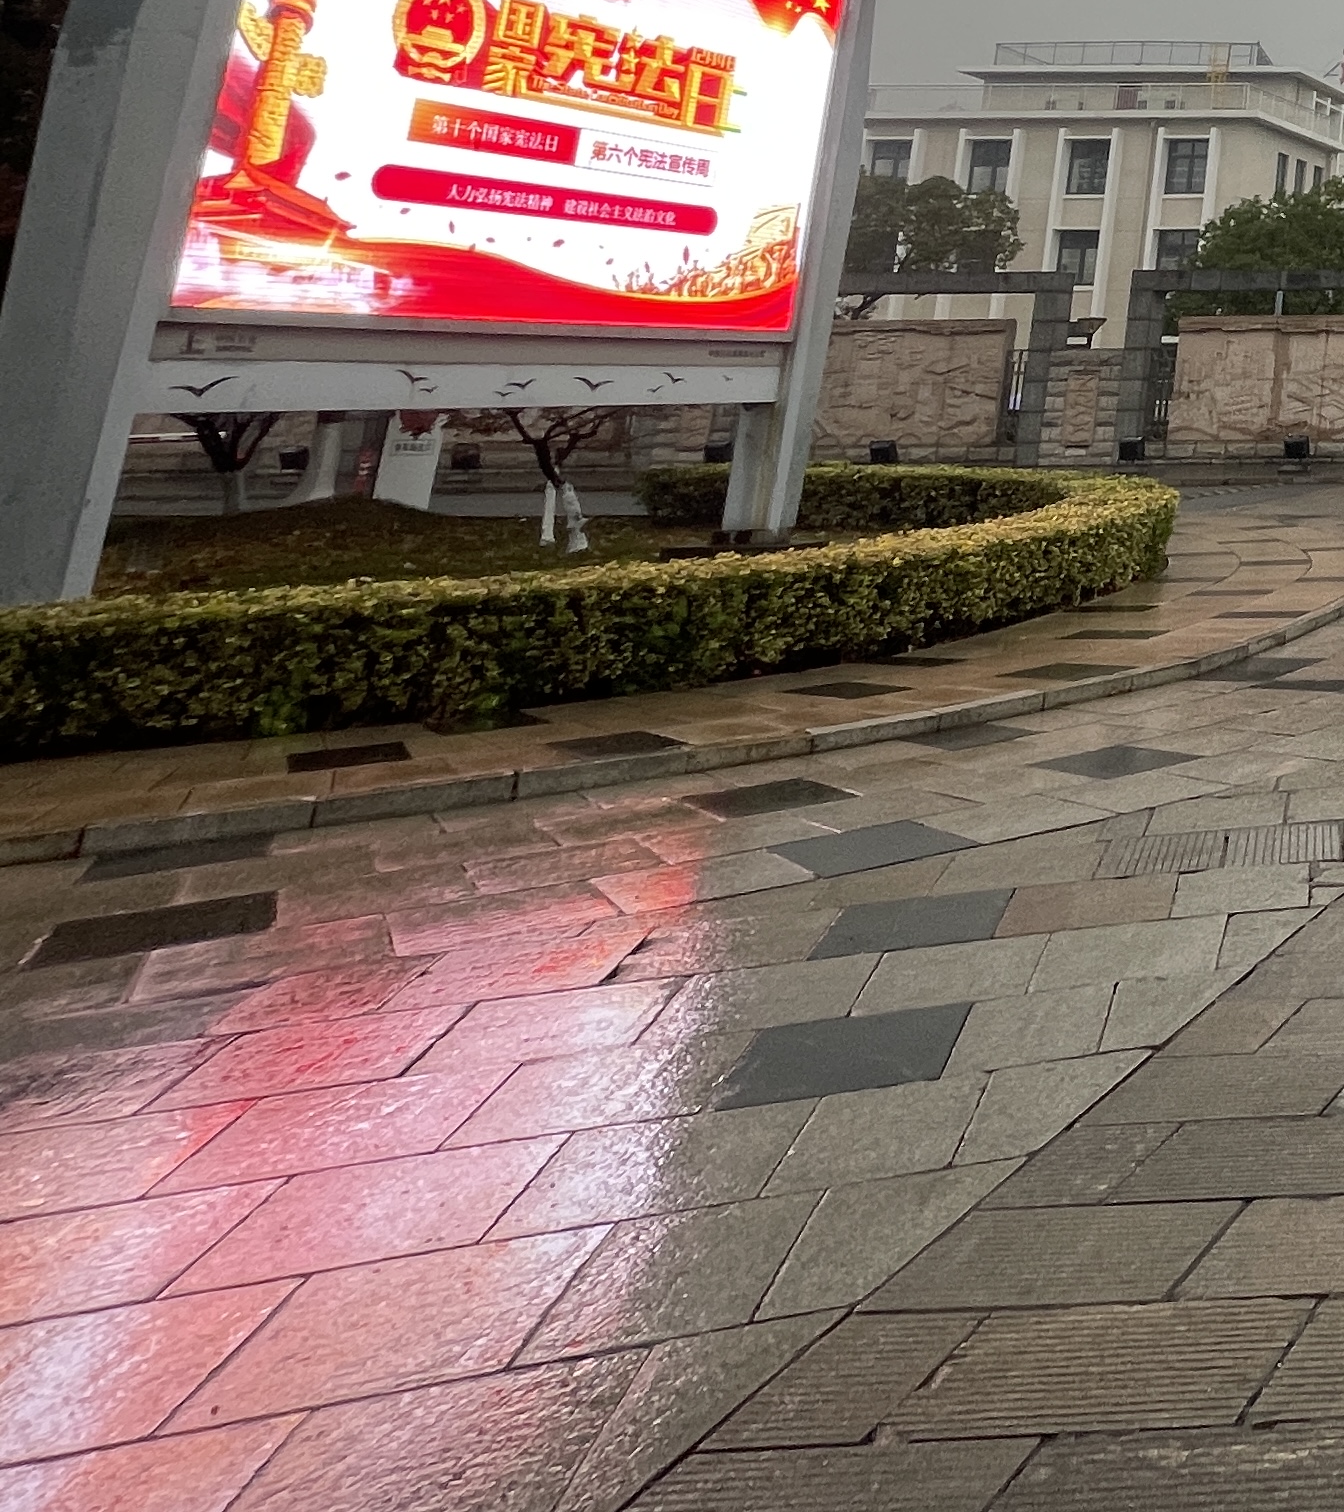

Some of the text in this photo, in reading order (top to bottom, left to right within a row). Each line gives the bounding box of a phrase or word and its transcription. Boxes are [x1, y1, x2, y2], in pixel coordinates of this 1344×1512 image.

[431, 114, 560, 153] 第十个国家宪法日
[590, 140, 711, 178] 第六个宪法宣传周
